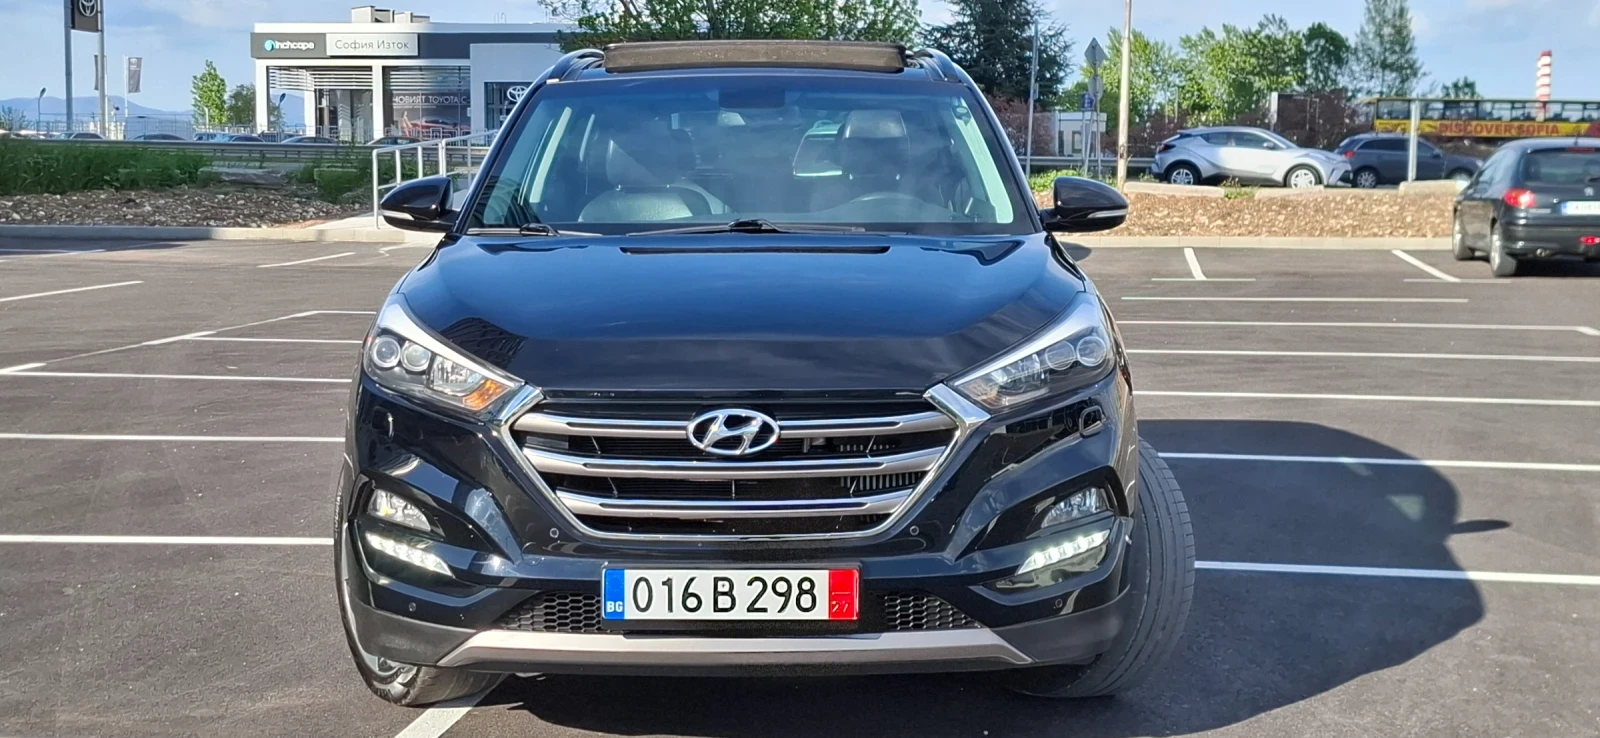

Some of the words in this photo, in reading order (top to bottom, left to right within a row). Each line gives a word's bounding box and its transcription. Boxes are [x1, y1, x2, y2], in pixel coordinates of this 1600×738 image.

[335, 39, 374, 50] София
[377, 39, 409, 49] Изток
[428, 96, 459, 104] TOYOTA
[1439, 122, 1514, 135] DISCOVER
[1515, 124, 1560, 136] SOFIA
[606, 600, 623, 612] BG
